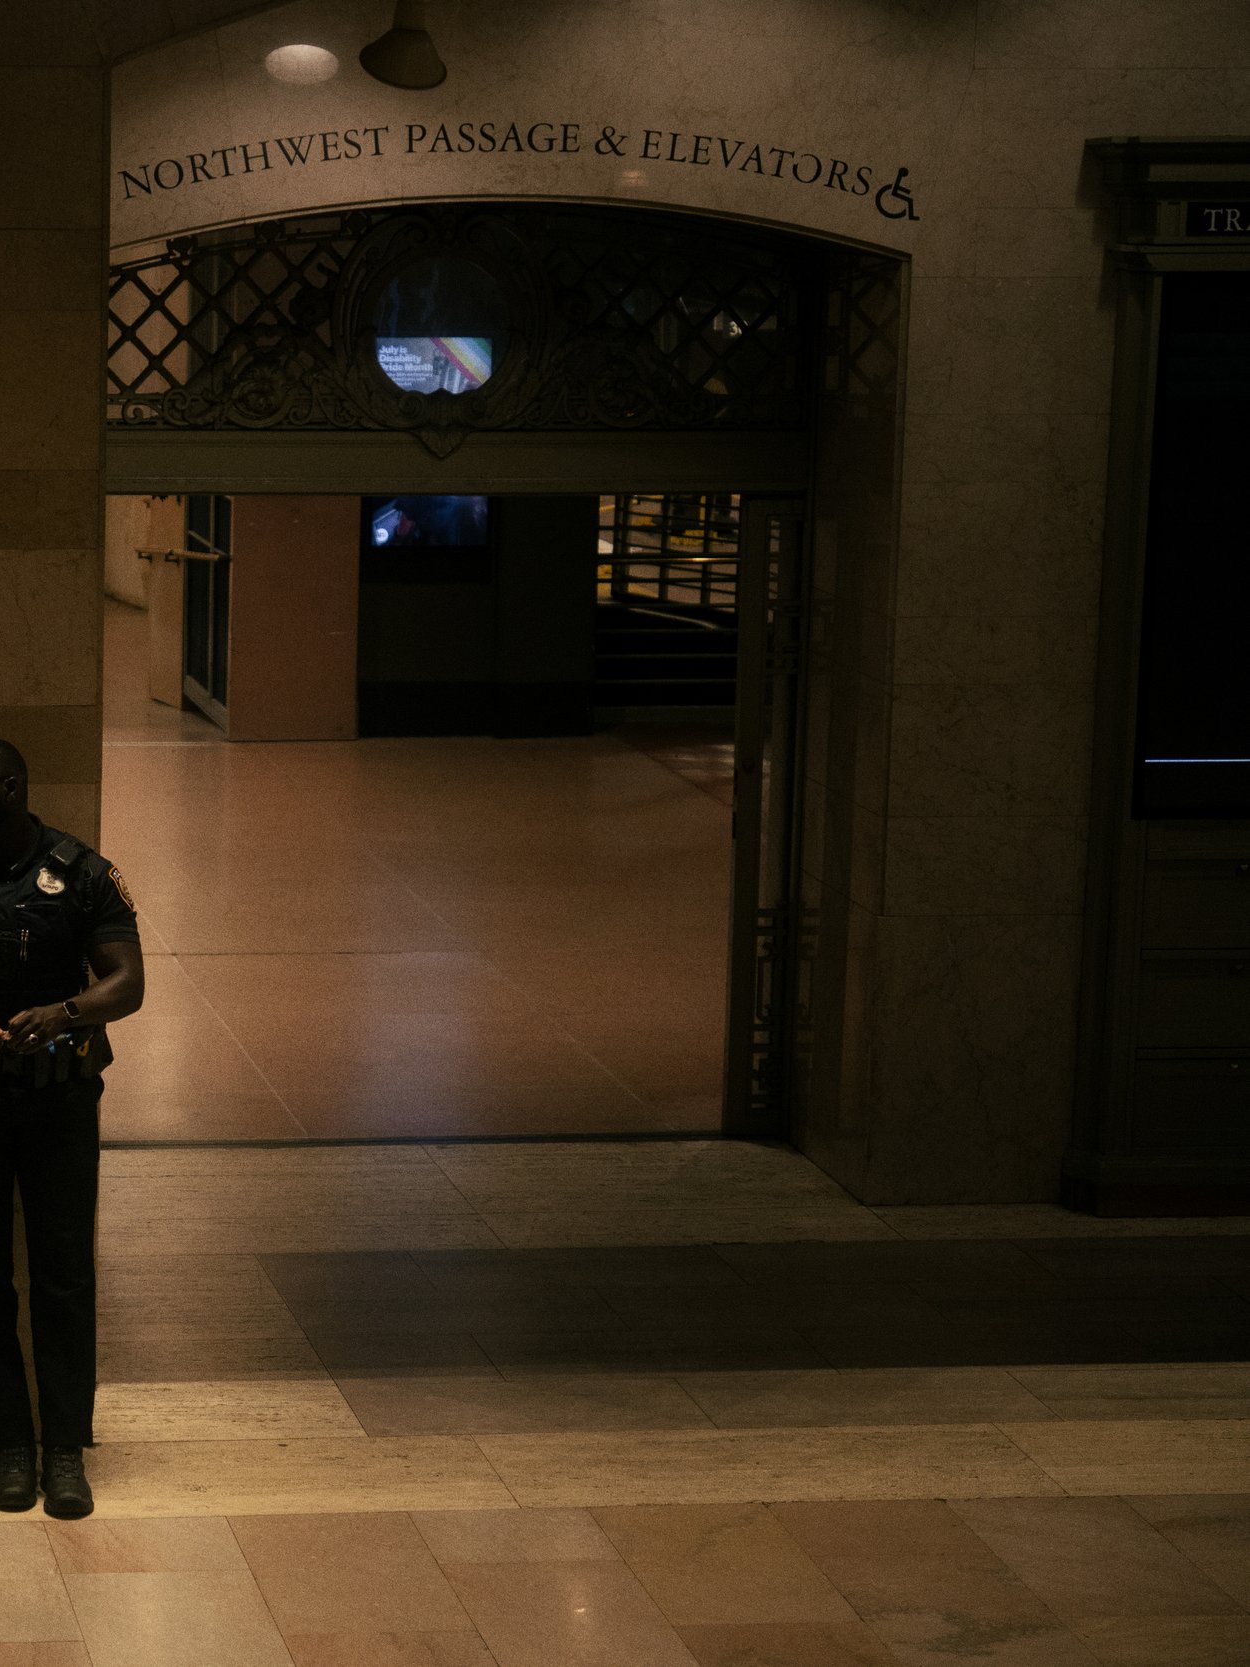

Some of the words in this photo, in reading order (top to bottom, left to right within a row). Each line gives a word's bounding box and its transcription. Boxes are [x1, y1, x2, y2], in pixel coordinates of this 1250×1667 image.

[117, 125, 390, 200] NORTHWEST
[404, 121, 582, 154] PASSAGE
[594, 125, 629, 157] &
[638, 129, 874, 197] ELEVATORS
[1203, 207, 1250, 232] TR
[379, 345, 399, 355] July
[379, 354, 422, 364] Disability
[404, 363, 433, 372] Month
